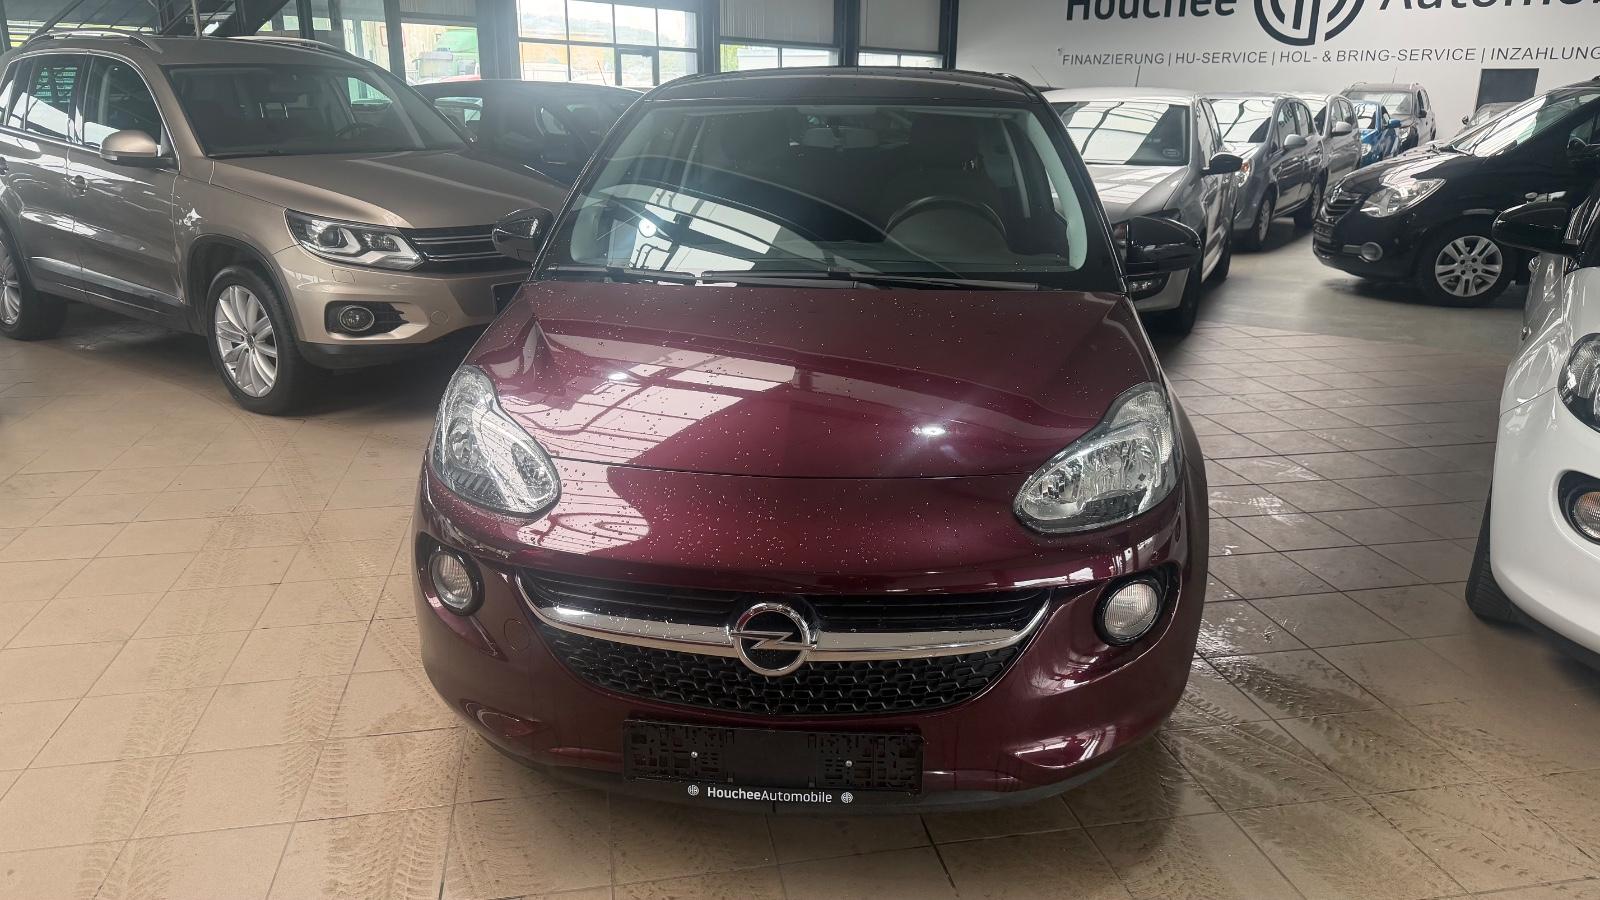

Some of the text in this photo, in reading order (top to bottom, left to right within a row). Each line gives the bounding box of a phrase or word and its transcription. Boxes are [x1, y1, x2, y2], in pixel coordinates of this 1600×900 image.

[1062, 53, 1165, 65] FINANZIERUNG
[1175, 52, 1268, 64] HU-SERVICE
[1279, 50, 1318, 63] HOL-
[1322, 51, 1332, 62] &
[1336, 48, 1477, 62] BRING-SERVICE
[707, 786, 833, 804] HoucheeAutomobile
